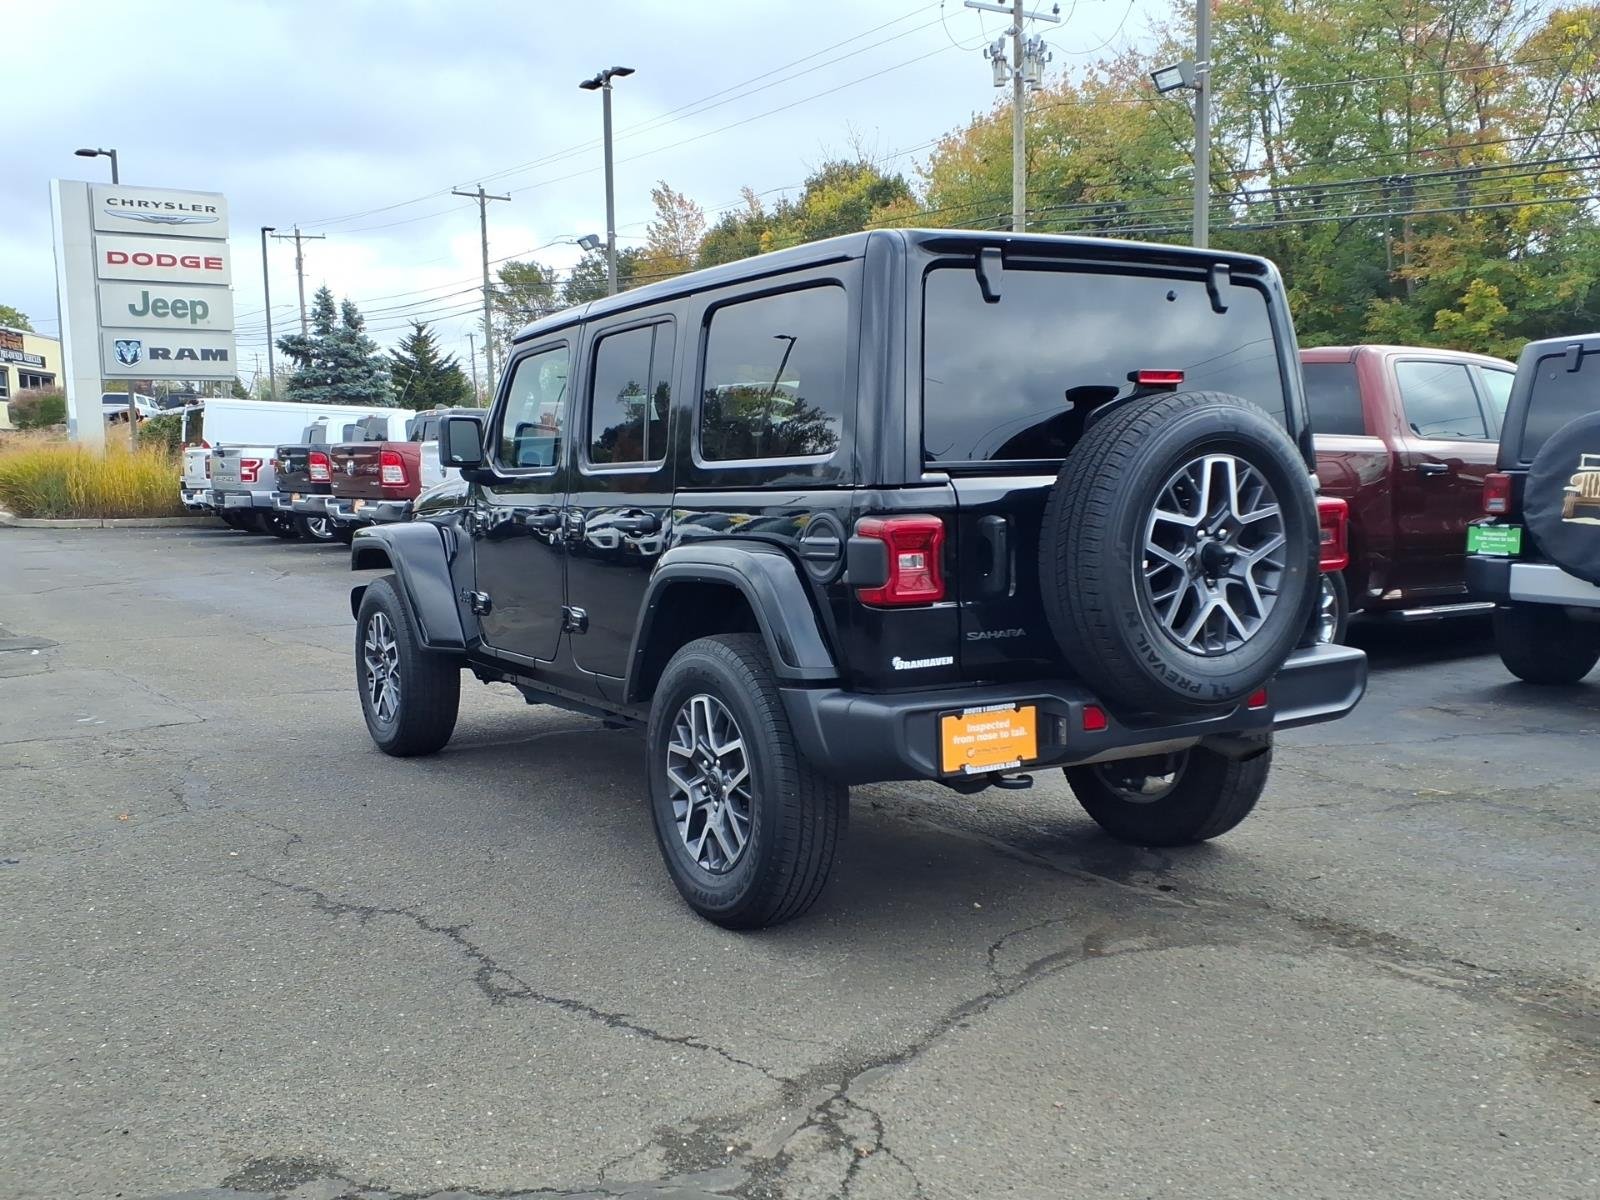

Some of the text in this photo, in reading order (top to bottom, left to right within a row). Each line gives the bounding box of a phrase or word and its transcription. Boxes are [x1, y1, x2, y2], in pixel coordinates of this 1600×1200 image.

[106, 197, 217, 213] CHRYSLER
[106, 251, 223, 270] DODGE
[128, 290, 209, 324] Jeep
[149, 347, 228, 361] RAM
[966, 628, 1026, 641] SAHARA
[894, 656, 954, 670] BRANHAVEN
[1136, 633, 1202, 694] PREVAIL
[953, 735, 975, 745] from
[977, 732, 998, 741] nose
